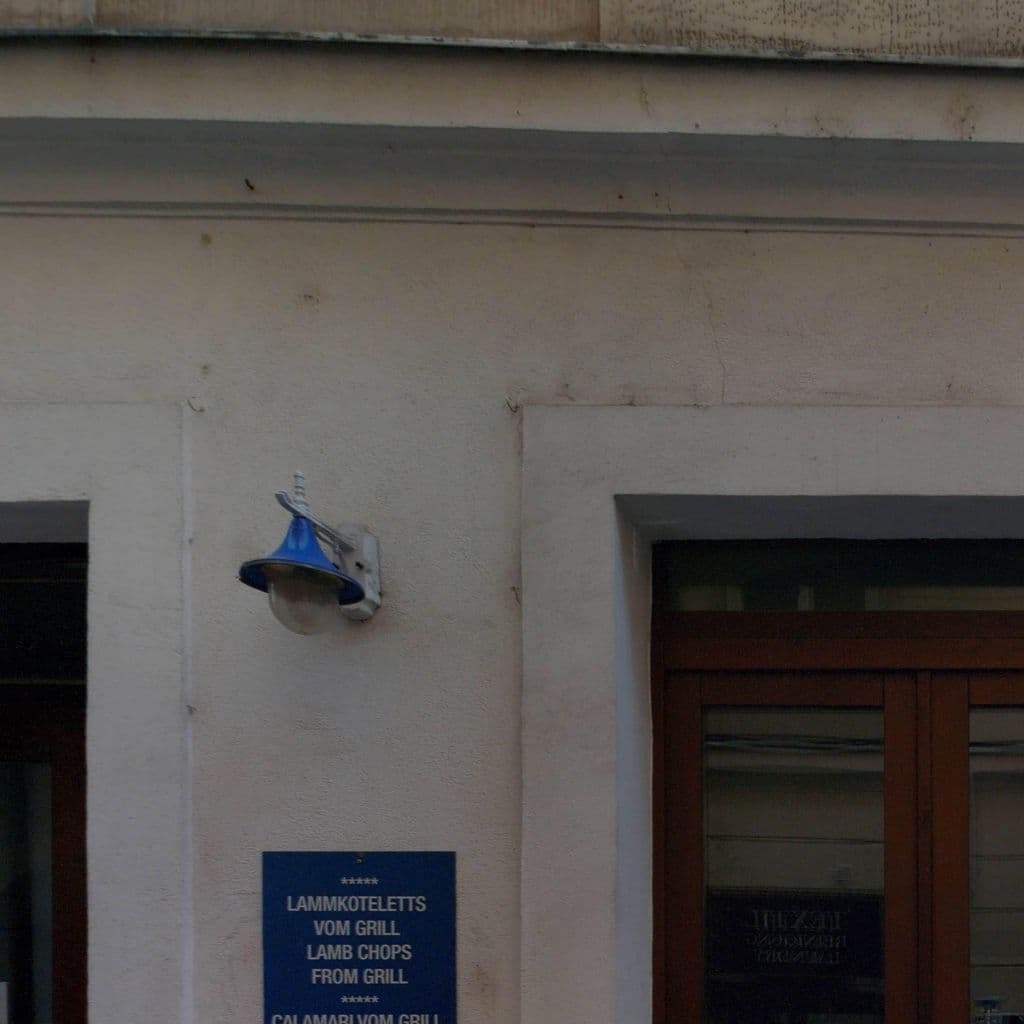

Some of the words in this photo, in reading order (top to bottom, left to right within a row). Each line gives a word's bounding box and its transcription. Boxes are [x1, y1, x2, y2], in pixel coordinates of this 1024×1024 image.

[287, 896, 426, 911] LAMMKOTELETTS
[314, 920, 350, 935] VOM
[355, 920, 400, 936] GRILL
[307, 945, 352, 960] LAMB
[358, 944, 412, 960] CHOPS
[312, 969, 358, 984] FROM
[363, 969, 407, 984] GRILL
